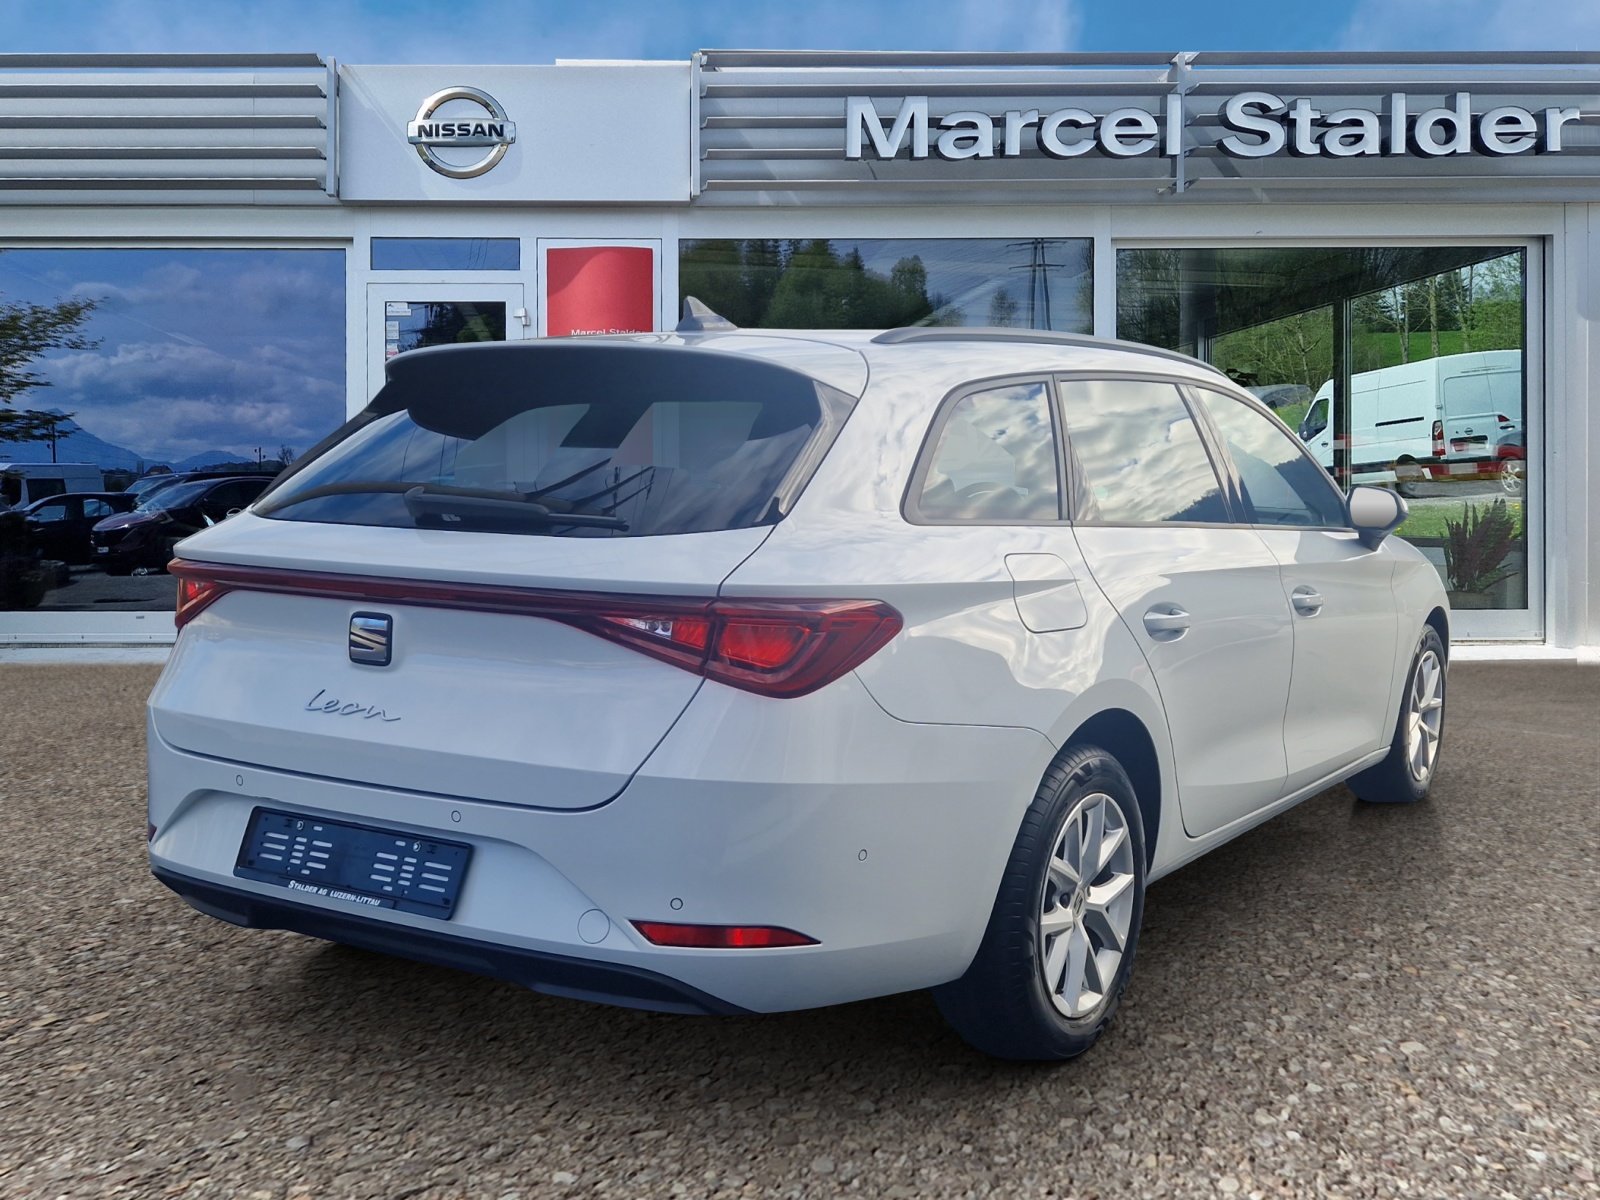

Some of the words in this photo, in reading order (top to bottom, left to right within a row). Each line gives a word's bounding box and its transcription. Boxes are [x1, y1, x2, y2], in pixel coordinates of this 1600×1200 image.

[417, 123, 504, 137] NISSAN
[845, 93, 1182, 162] Marcel
[1216, 91, 1580, 159] Stalder
[571, 328, 606, 336] Marcel
[305, 688, 402, 722] Leon
[288, 880, 318, 895] STALDER
[318, 887, 328, 896] AG
[329, 890, 381, 906] LUZERN-LITTAU
